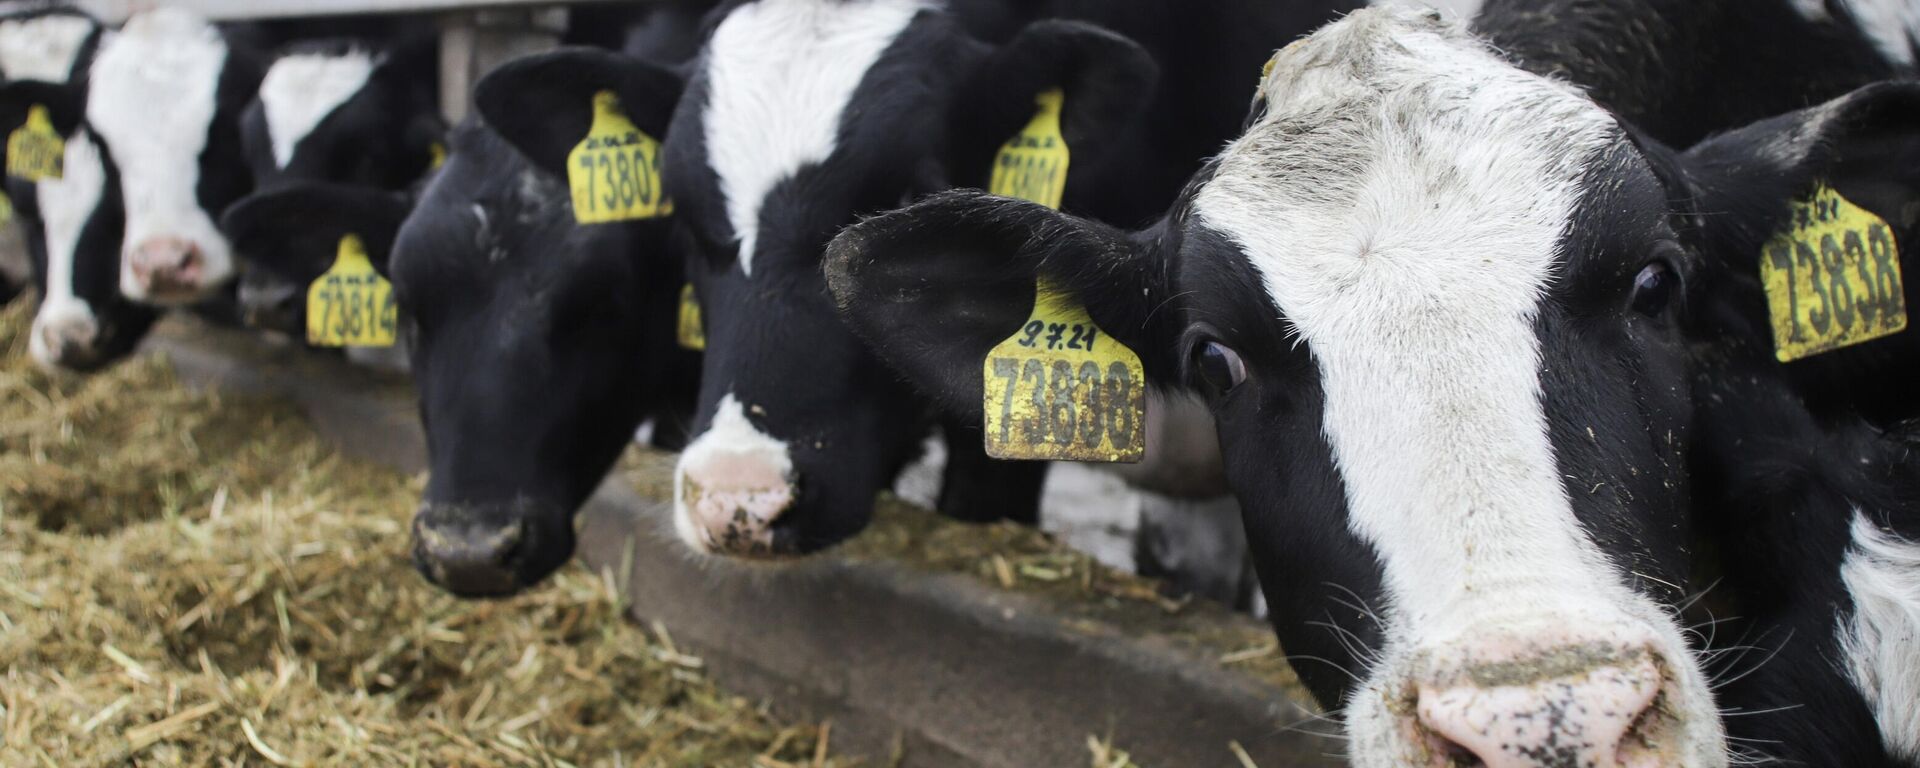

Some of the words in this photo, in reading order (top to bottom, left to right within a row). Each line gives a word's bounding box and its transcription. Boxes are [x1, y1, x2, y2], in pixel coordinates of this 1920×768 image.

[580, 149, 660, 212] 7380
[319, 289, 394, 338] 73814
[1768, 223, 1902, 343] 73838
[1018, 319, 1097, 352] 9.7.21
[993, 357, 1132, 449] 73838
